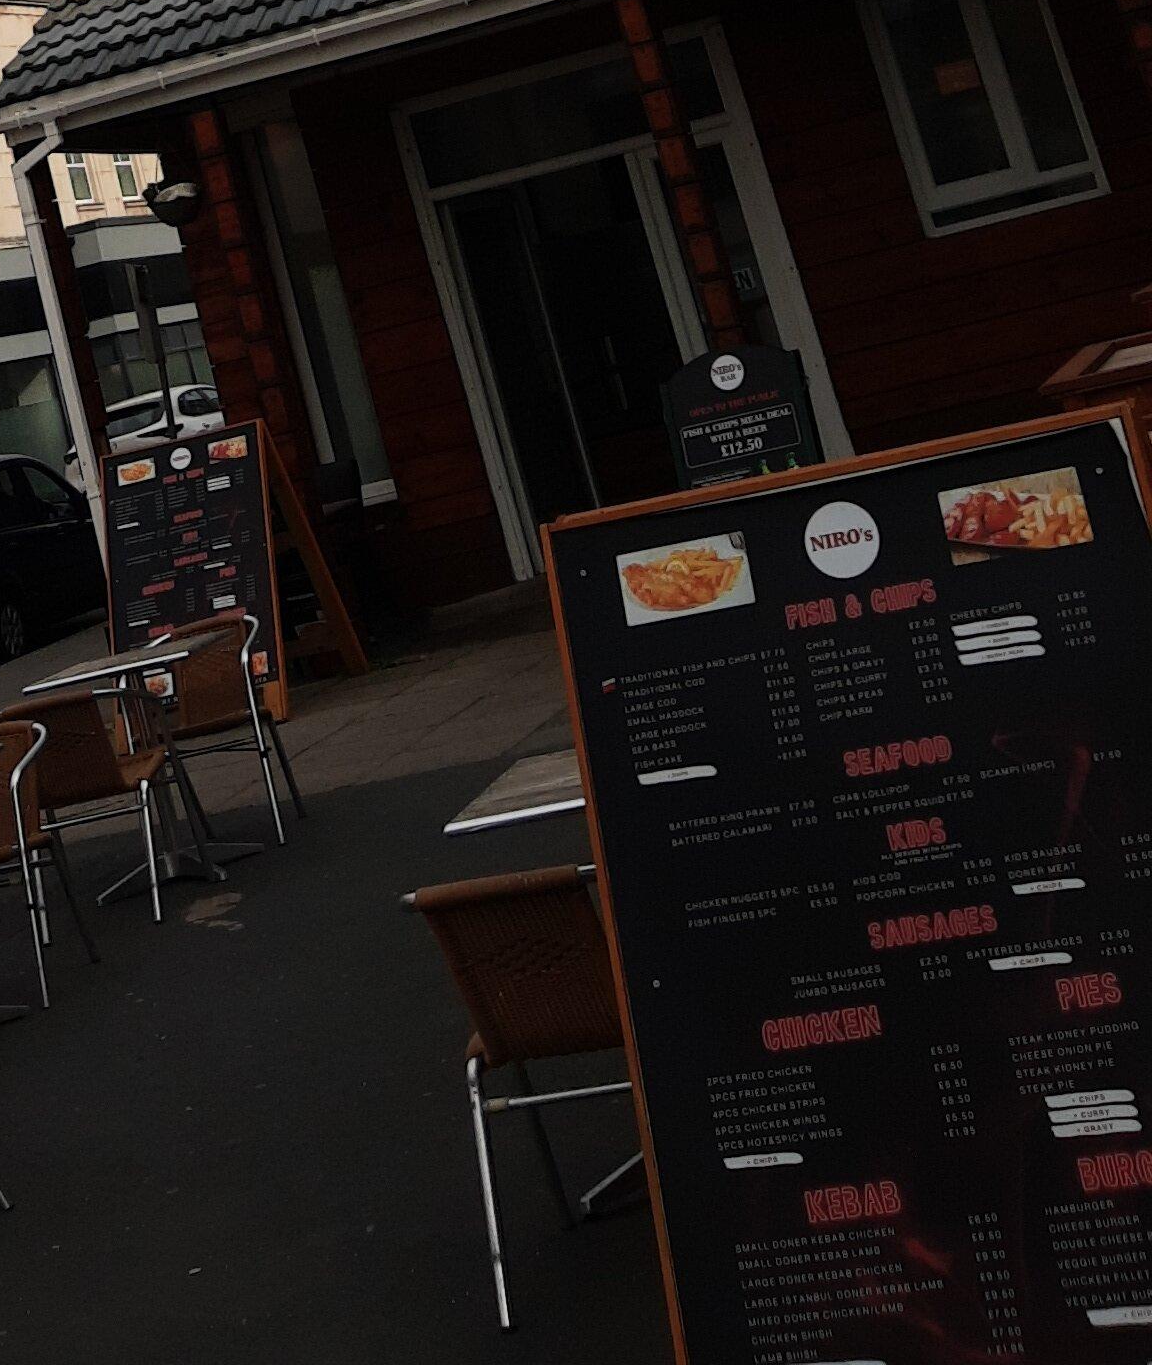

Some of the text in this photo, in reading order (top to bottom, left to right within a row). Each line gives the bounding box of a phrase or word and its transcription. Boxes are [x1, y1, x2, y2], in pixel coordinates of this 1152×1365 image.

[683, 427, 704, 438] FISH
[712, 419, 740, 433] CHIPS
[767, 407, 792, 419] DEAL
[720, 437, 764, 457] £12.50
[809, 528, 874, 552] NIRO's
[784, 578, 937, 630] FISH & CHIPS
[619, 667, 679, 684] TRADITIONAL
[622, 681, 682, 698] TRADITIONAL
[841, 733, 954, 778] SEAFOOD
[885, 815, 947, 851] KIDS
[866, 903, 998, 949] SAUSAGES
[966, 935, 1083, 960] BATTERED SAUSAGES
[1054, 970, 1123, 1010] PIES
[759, 1004, 882, 1051] CHICKEN
[1008, 1020, 1139, 1046] STEAK KIDNEY PUDDING
[1011, 1048, 1053, 1062] CHEESE
[1056, 1043, 1092, 1056] ONION
[735, 1071, 764, 1082] FRIED
[766, 1064, 812, 1078] CHICKEN
[1015, 1066, 1050, 1079] STEAK
[1053, 1060, 1093, 1074] KIDNEY
[738, 1080, 815, 1099] FRIED CHICKEN
[1018, 1081, 1053, 1095] STEAK
[741, 1096, 825, 1116] CHICKEN STRIPS
[743, 1113, 826, 1132] CHICKEN WINGS
[808, 1127, 843, 1140] WINGS
[803, 1180, 902, 1223] KEBAB
[1044, 1199, 1114, 1215] HAMBURGER
[1048, 1214, 1140, 1233] CHEESE BURGER
[734, 1241, 769, 1254] SMALL
[810, 1232, 845, 1245] KEBAB
[848, 1226, 895, 1240] CHICKEN
[1052, 1237, 1096, 1251] DOUBLE
[737, 1258, 772, 1270] SMALL
[740, 1277, 775, 1289] LARGE
[817, 1268, 852, 1281] KEBAB
[855, 1262, 902, 1276] CHICKEN
[1060, 1273, 1111, 1288] CHICKEN
[744, 1297, 778, 1310] LARGE
[751, 1332, 797, 1345] CHICKEN
